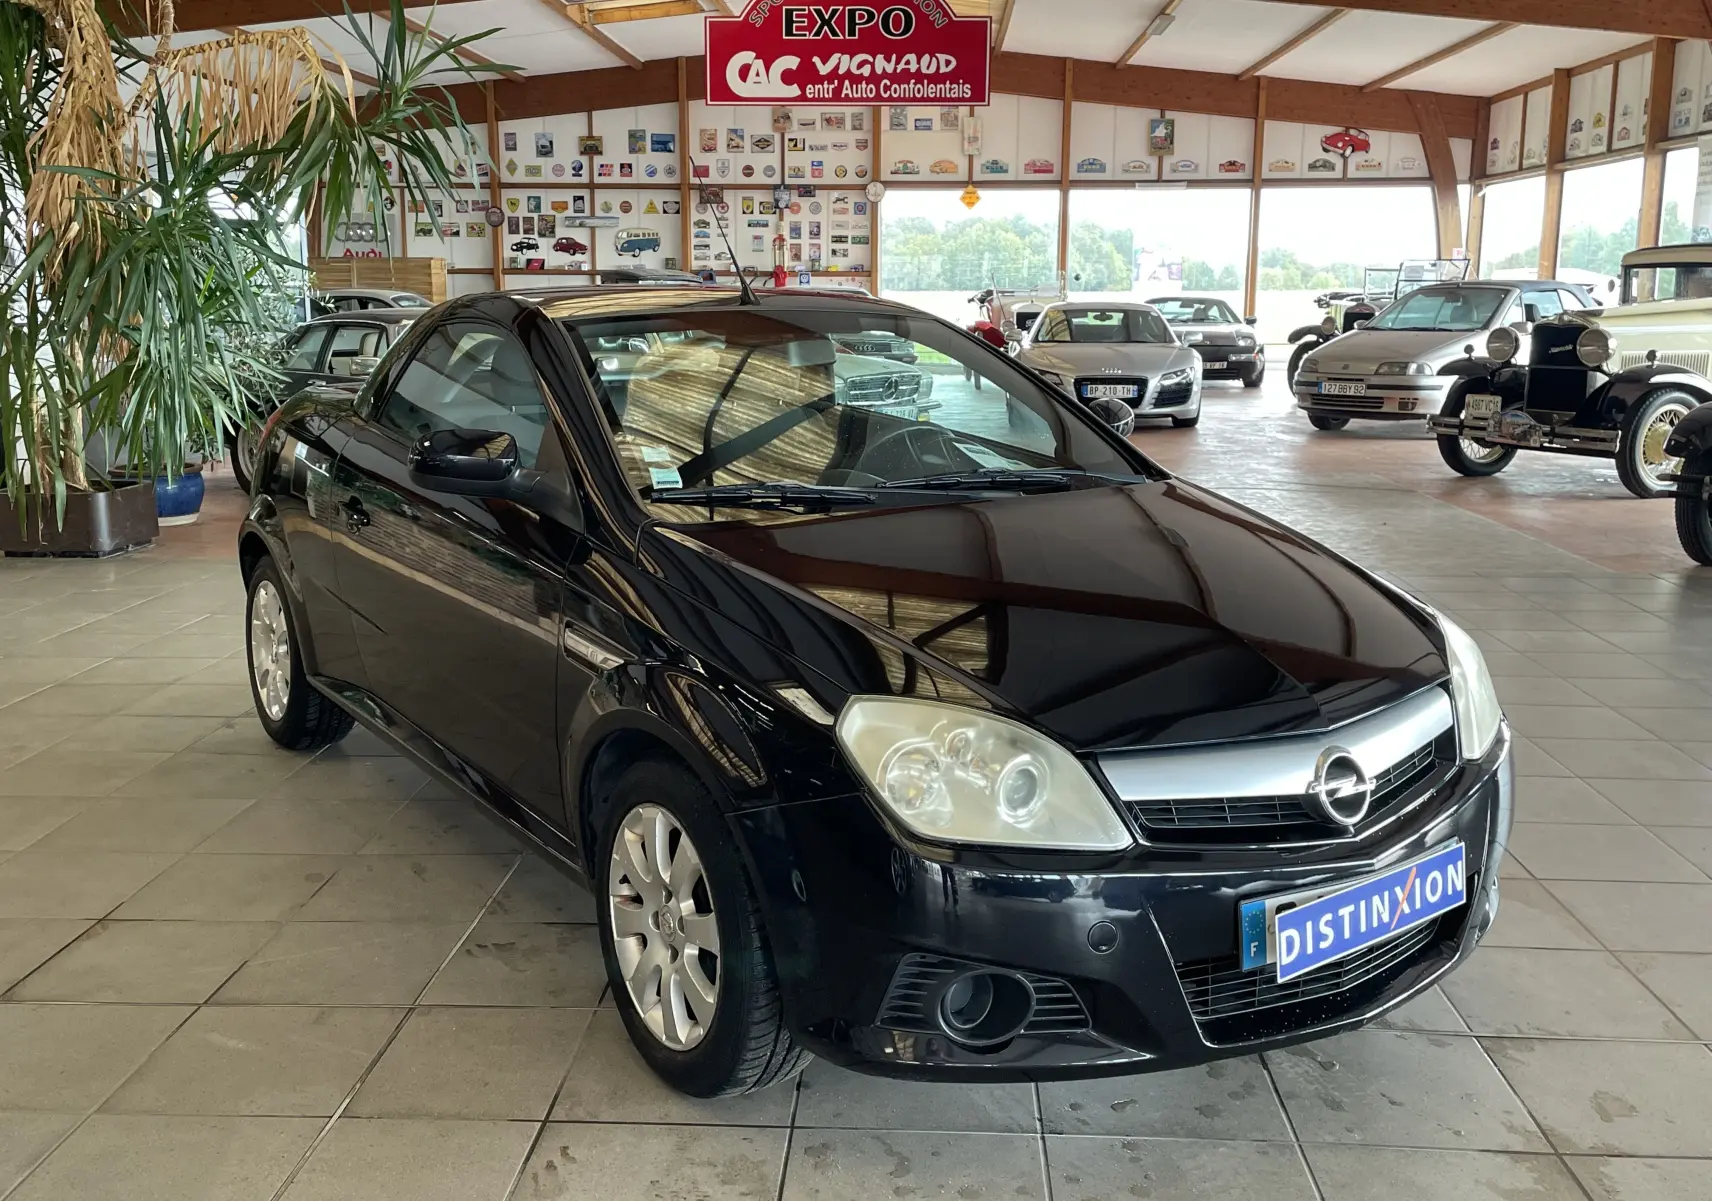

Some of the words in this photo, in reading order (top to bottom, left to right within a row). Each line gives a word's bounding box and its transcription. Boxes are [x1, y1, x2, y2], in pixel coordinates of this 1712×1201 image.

[782, 6, 916, 39] EXPO
[725, 50, 802, 98] CAC
[811, 53, 957, 77] VIGNAUD
[841, 79, 876, 98] Auto
[880, 78, 972, 98] Confolentais
[1280, 860, 1463, 966] DISTINXION
[1250, 942, 1258, 957] F
